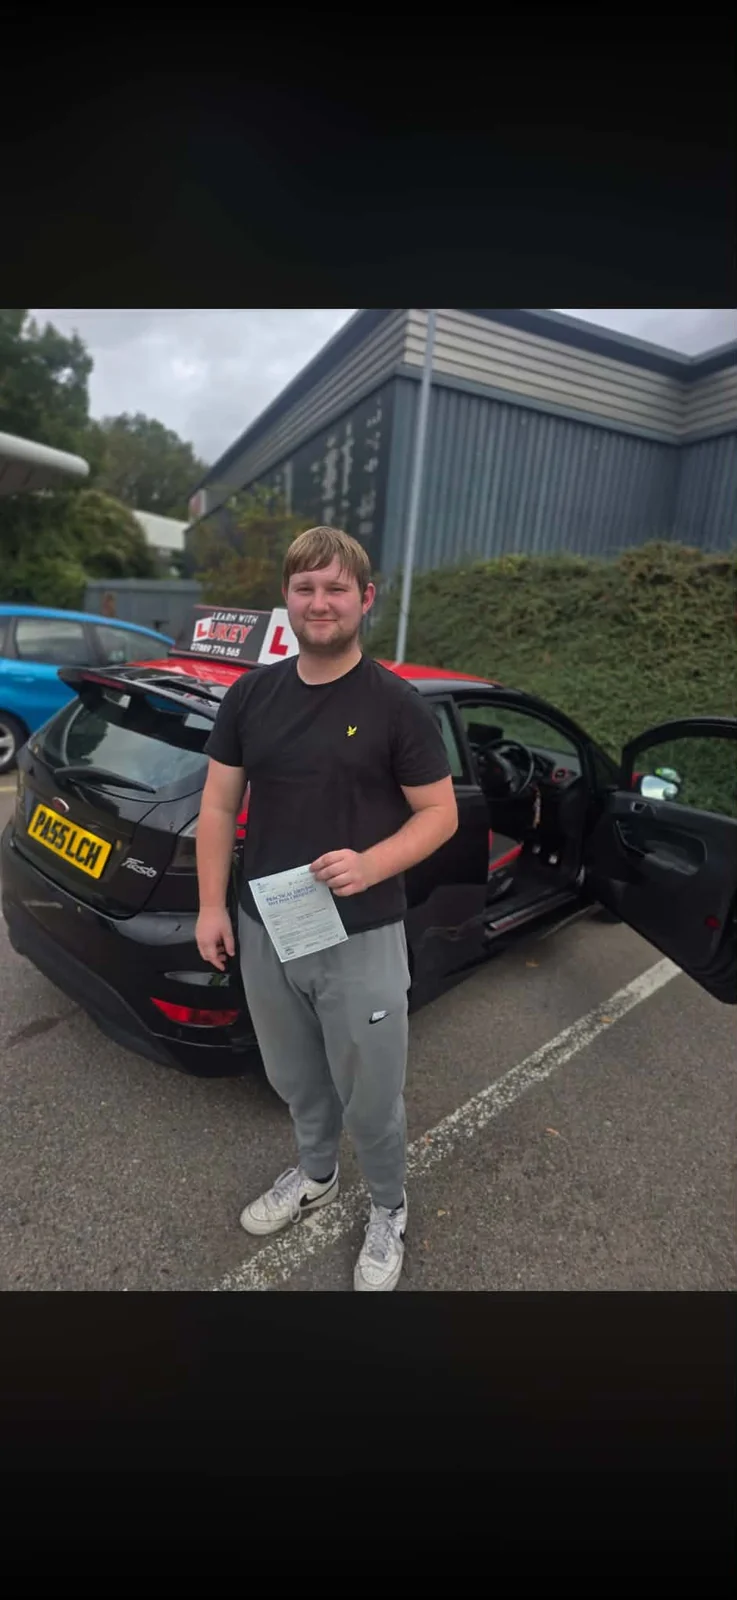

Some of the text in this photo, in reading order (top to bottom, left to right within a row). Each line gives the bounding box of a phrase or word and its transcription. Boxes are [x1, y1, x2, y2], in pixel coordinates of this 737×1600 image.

[212, 612, 259, 624] LEARN WITH
[196, 622, 253, 643] LUKEY
[269, 626, 288, 656] L
[65, 831, 102, 870] LCH
